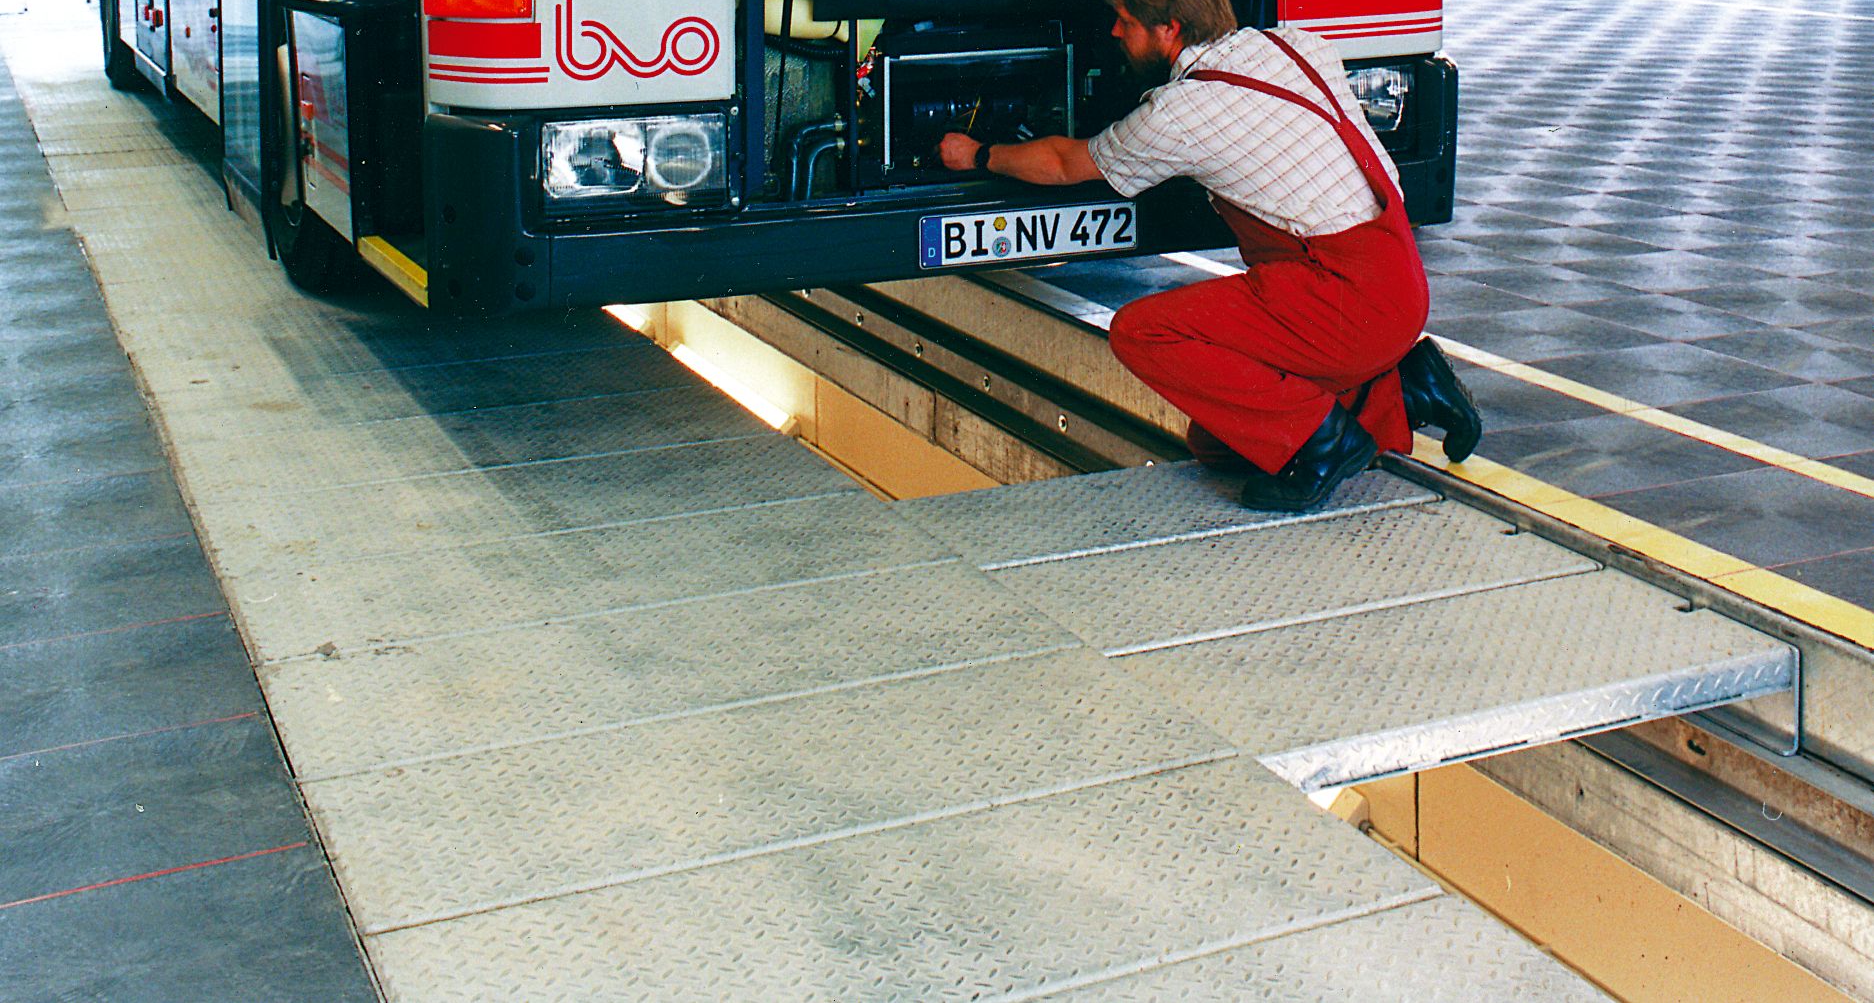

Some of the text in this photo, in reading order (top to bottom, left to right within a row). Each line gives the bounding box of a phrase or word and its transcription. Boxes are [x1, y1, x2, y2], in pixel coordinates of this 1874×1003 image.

[944, 206, 1133, 259] BI NV 472
[928, 247, 936, 258] D
